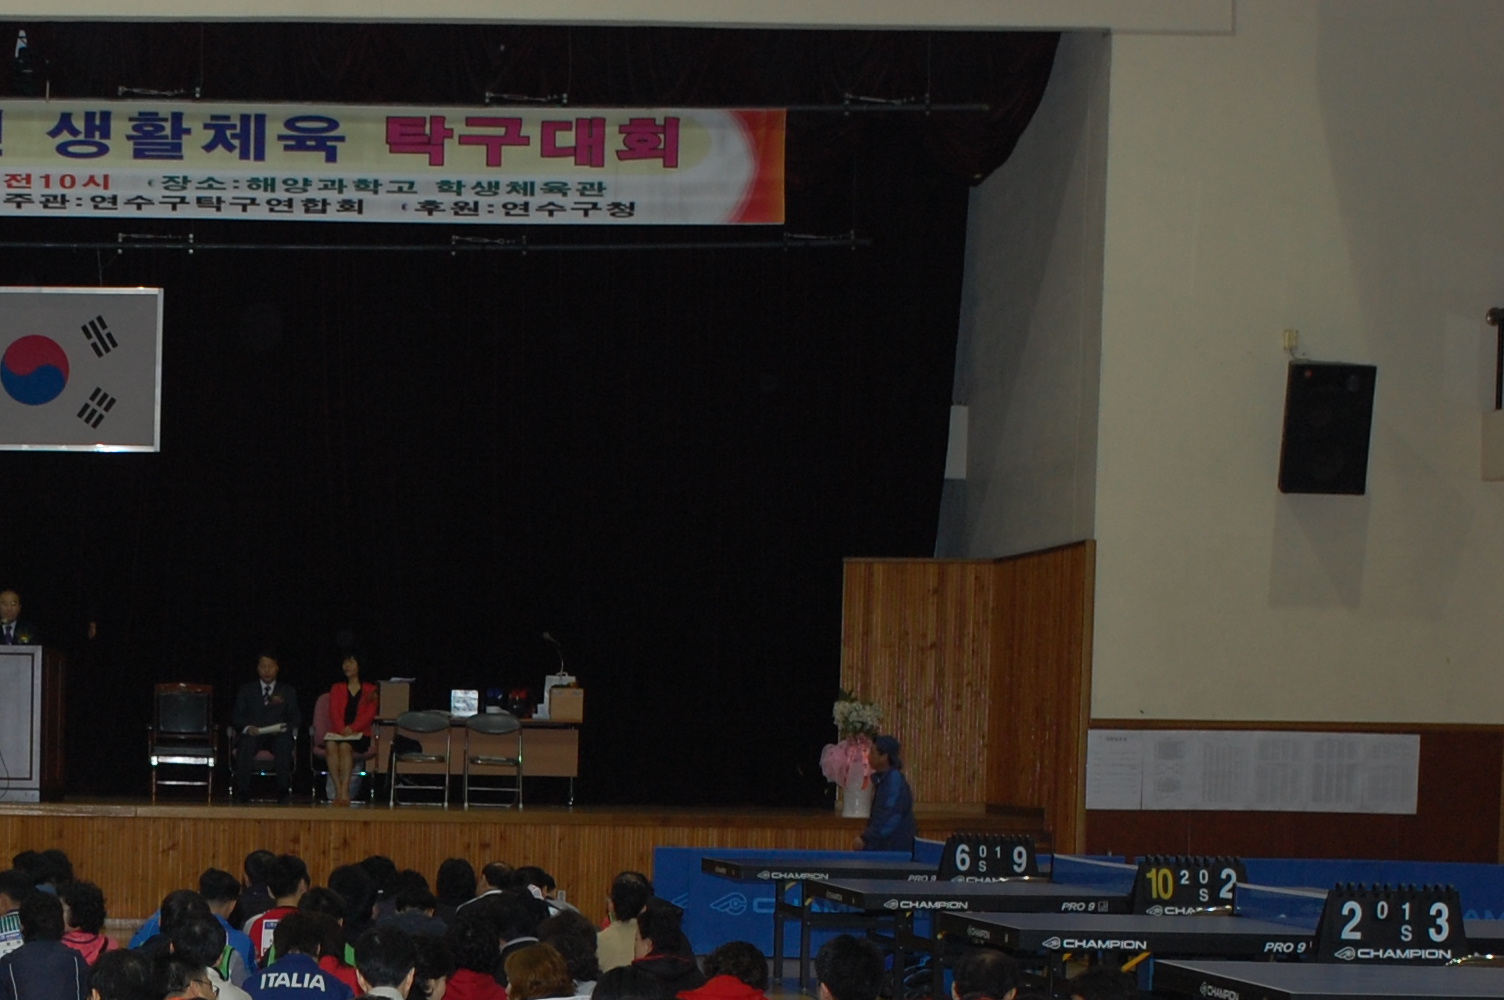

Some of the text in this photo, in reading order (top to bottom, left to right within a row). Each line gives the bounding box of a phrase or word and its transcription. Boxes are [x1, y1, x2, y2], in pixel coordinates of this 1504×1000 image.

[46, 109, 346, 163] 생활체육
[385, 113, 680, 168] 탁구대회
[161, 174, 608, 198] 장소:해양과학고 학생체육관
[4, 193, 365, 215] 주관:연수구탁구연합회
[414, 199, 636, 218] 후원:연수구청
[956, 844, 1027, 873] 6 0 1 9
[979, 861, 987, 872] S
[771, 871, 829, 880] CHAMPION
[1147, 867, 1237, 899] 10 2 0 2
[900, 900, 968, 909] CHAMPION
[1200, 889, 1209, 902] S
[1061, 901, 1095, 911] PRO 9
[1341, 901, 1362, 940] 2
[1377, 901, 1389, 920] 0
[1402, 902, 1410, 921] 1
[1429, 902, 1449, 942] 3
[1401, 924, 1413, 942] S
[1063, 938, 1147, 949] CHAMPION
[1264, 942, 1306, 953] PRO 9
[1357, 948, 1452, 960] CHAMPION
[260, 972, 326, 992] ITALIA
